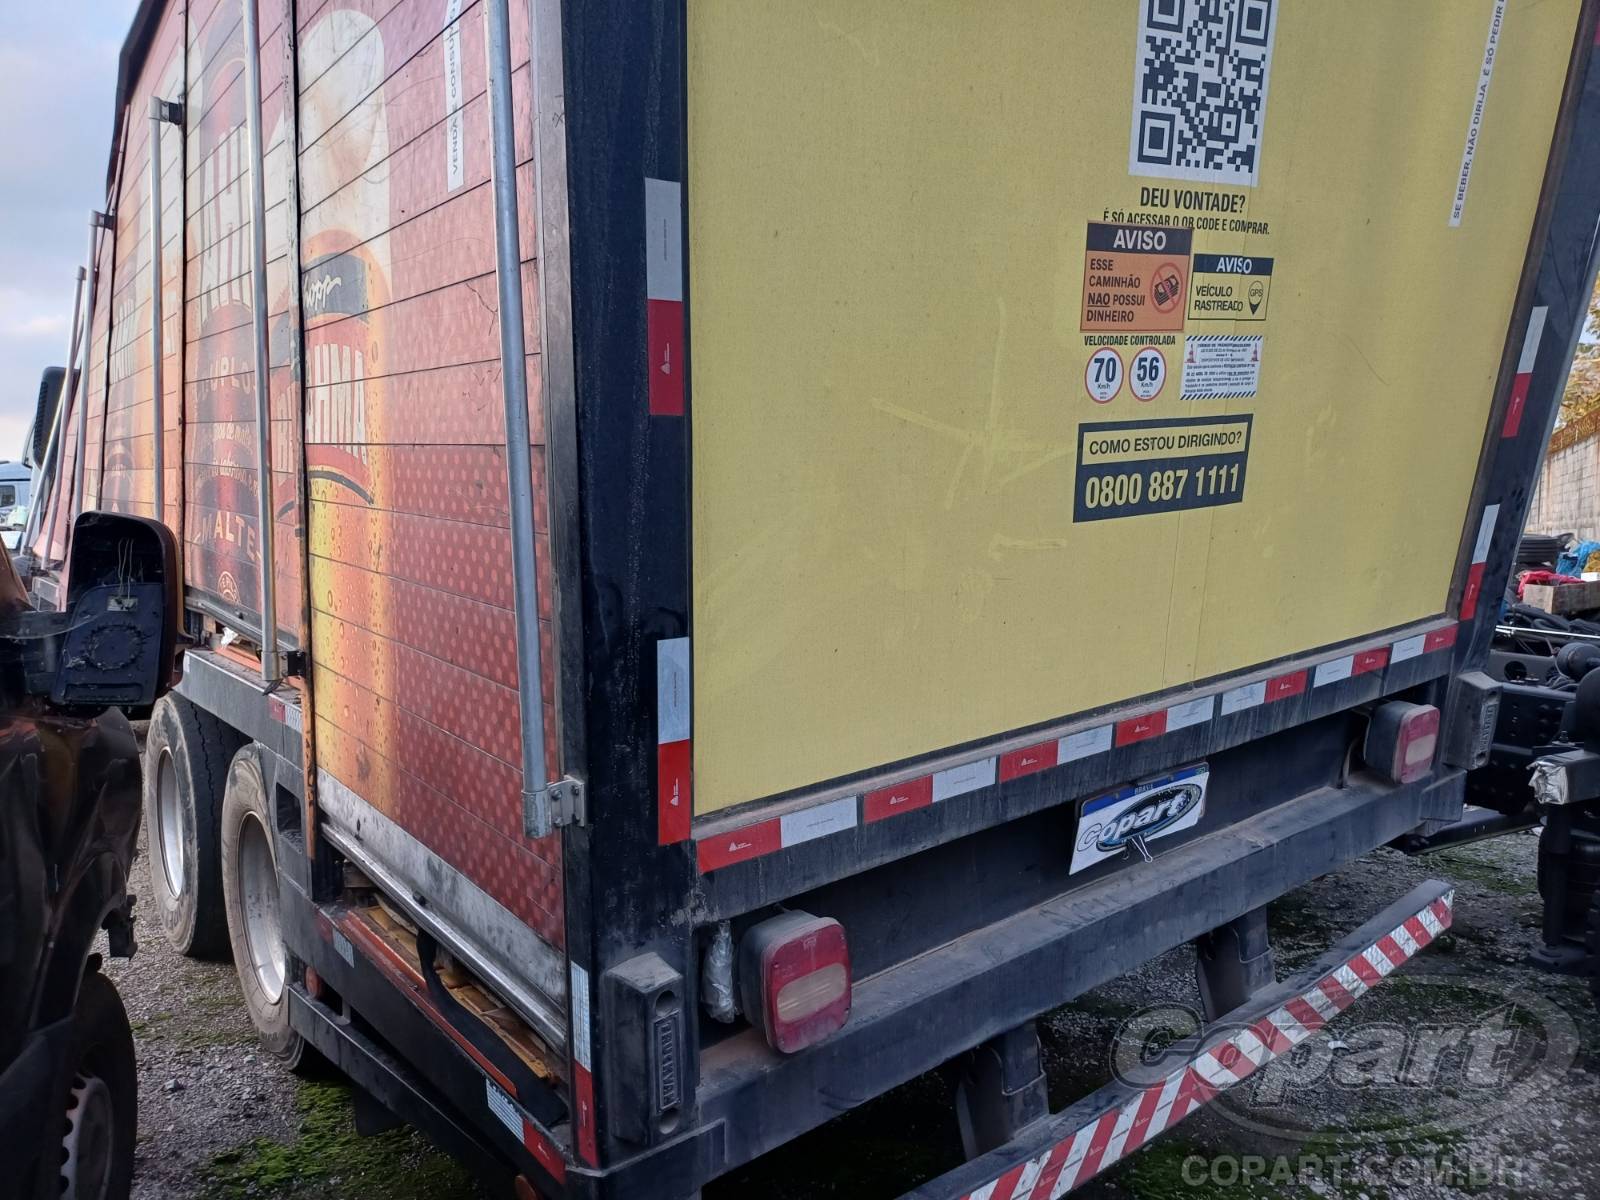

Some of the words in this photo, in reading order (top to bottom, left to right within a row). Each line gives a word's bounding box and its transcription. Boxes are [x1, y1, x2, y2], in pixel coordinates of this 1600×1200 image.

[1490, 5, 1504, 44] PEDIR
[450, 118, 459, 175] VENDA
[1466, 128, 1478, 155] NÃO
[1457, 159, 1473, 201] BEBER,
[1140, 186, 1170, 208] DEU
[1174, 189, 1246, 213] VONTADE?
[1453, 203, 1462, 219] SE
[1111, 208, 1125, 223] SÓ
[1127, 212, 1170, 226] ACESSAR
[1196, 217, 1220, 231] CODE
[1222, 218, 1228, 231] E
[1113, 229, 1167, 250] AVISO
[1090, 258, 1114, 271] ESSE
[1216, 256, 1252, 274] AVISO
[1089, 274, 1141, 289] CAMINHÃO
[1196, 283, 1233, 297] VEÍCULO
[1250, 288, 1264, 297] GPS
[1112, 294, 1145, 306] POSSUI
[1194, 300, 1244, 312] RASTREADO
[1086, 309, 1134, 322] DINHEIRO
[1084, 335, 1129, 346] VELOCIDADE
[1130, 335, 1176, 346] CONTROLADA
[1093, 357, 1117, 383] 70
[1137, 357, 1160, 382] 56
[1089, 438, 1130, 455] COMO
[1134, 434, 1175, 452] ESTOU
[1177, 431, 1242, 449] DIRIGINDO?
[1085, 473, 1142, 509] 0800
[1148, 469, 1189, 502] 887
[1195, 463, 1239, 496] 1111
[202, 510, 256, 561] MALTE
[1077, 792, 1188, 851] Copart
